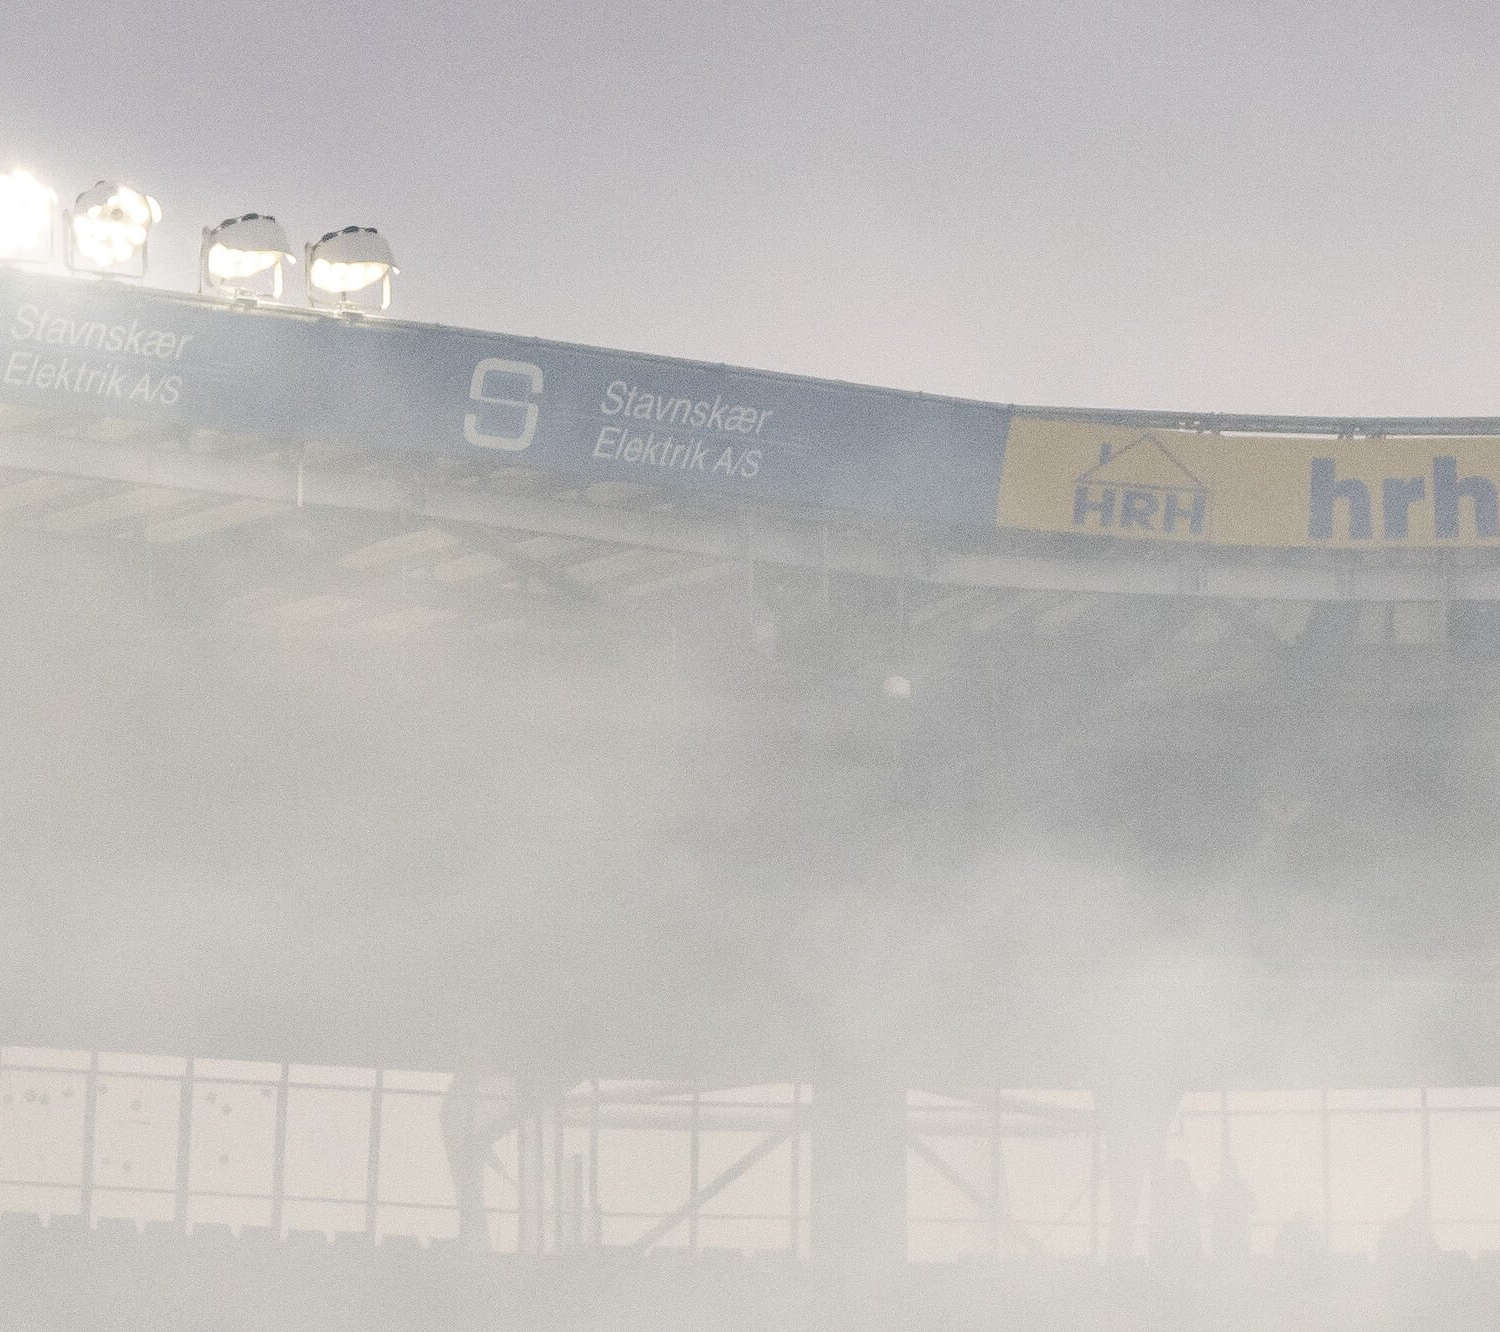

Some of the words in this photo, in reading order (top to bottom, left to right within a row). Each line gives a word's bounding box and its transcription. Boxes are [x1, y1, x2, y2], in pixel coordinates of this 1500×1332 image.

[3, 351, 124, 398] Elektrik
[600, 380, 775, 435] Stavnskær
[593, 426, 707, 472] Elektrik
[712, 447, 764, 480] A/S
[1072, 486, 1208, 533] HRH
